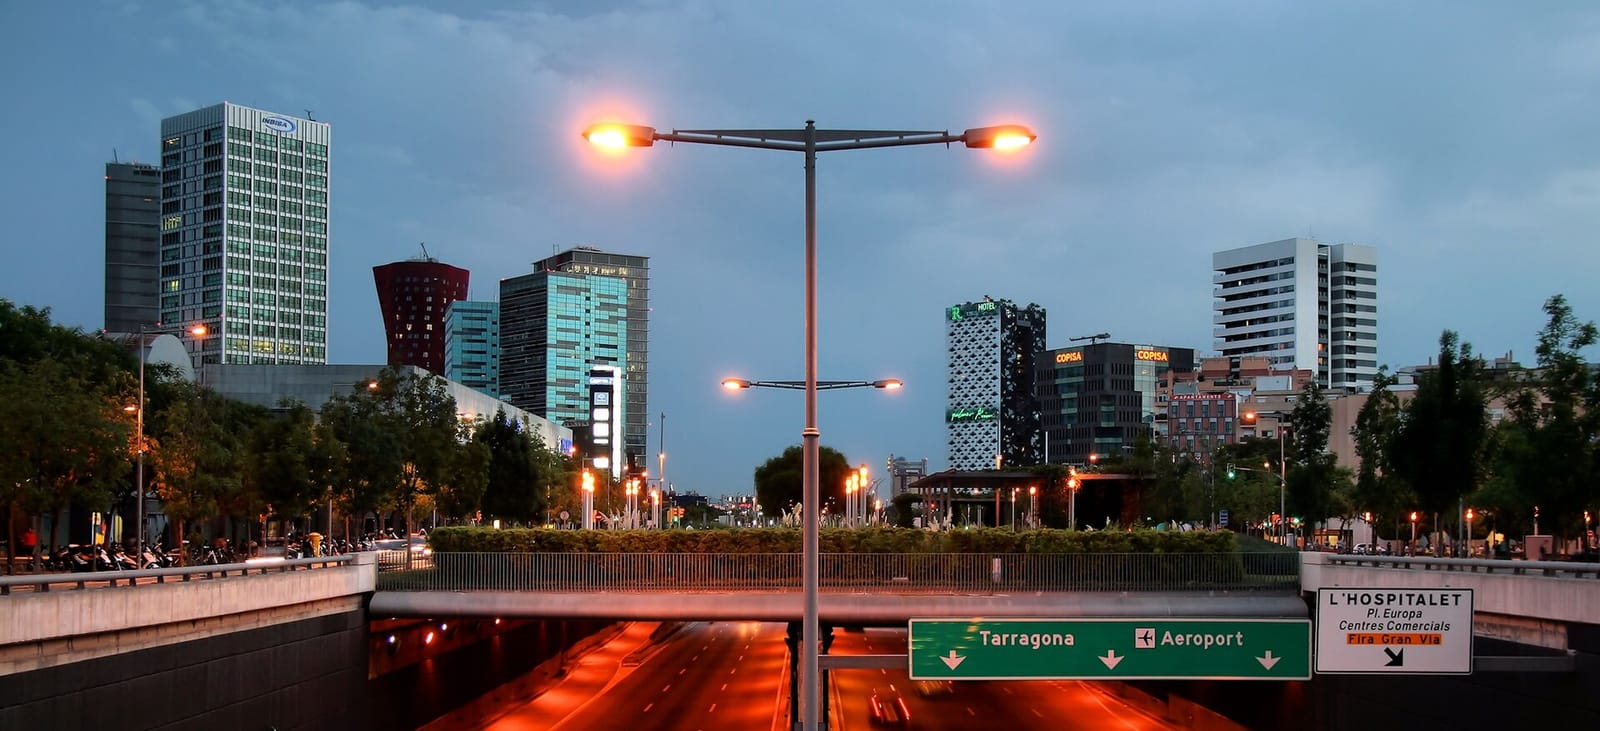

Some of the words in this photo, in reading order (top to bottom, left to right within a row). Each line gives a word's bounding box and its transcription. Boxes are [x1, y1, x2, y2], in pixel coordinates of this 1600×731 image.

[977, 302, 996, 312] HOTEL
[1056, 351, 1082, 364] COPISA
[1137, 350, 1168, 362] COPISA
[1329, 592, 1462, 606] L'HOSPITALET
[1366, 608, 1381, 618] Pl.
[1383, 608, 1423, 620] Europa
[1339, 620, 1384, 631] Centres
[1386, 620, 1451, 631] Comercials
[980, 630, 1075, 649] Tarragona
[1160, 630, 1244, 649] Aeroport
[1348, 634, 1374, 644] Fira
[1381, 634, 1412, 644] Gran
[1420, 634, 1441, 644] Via
